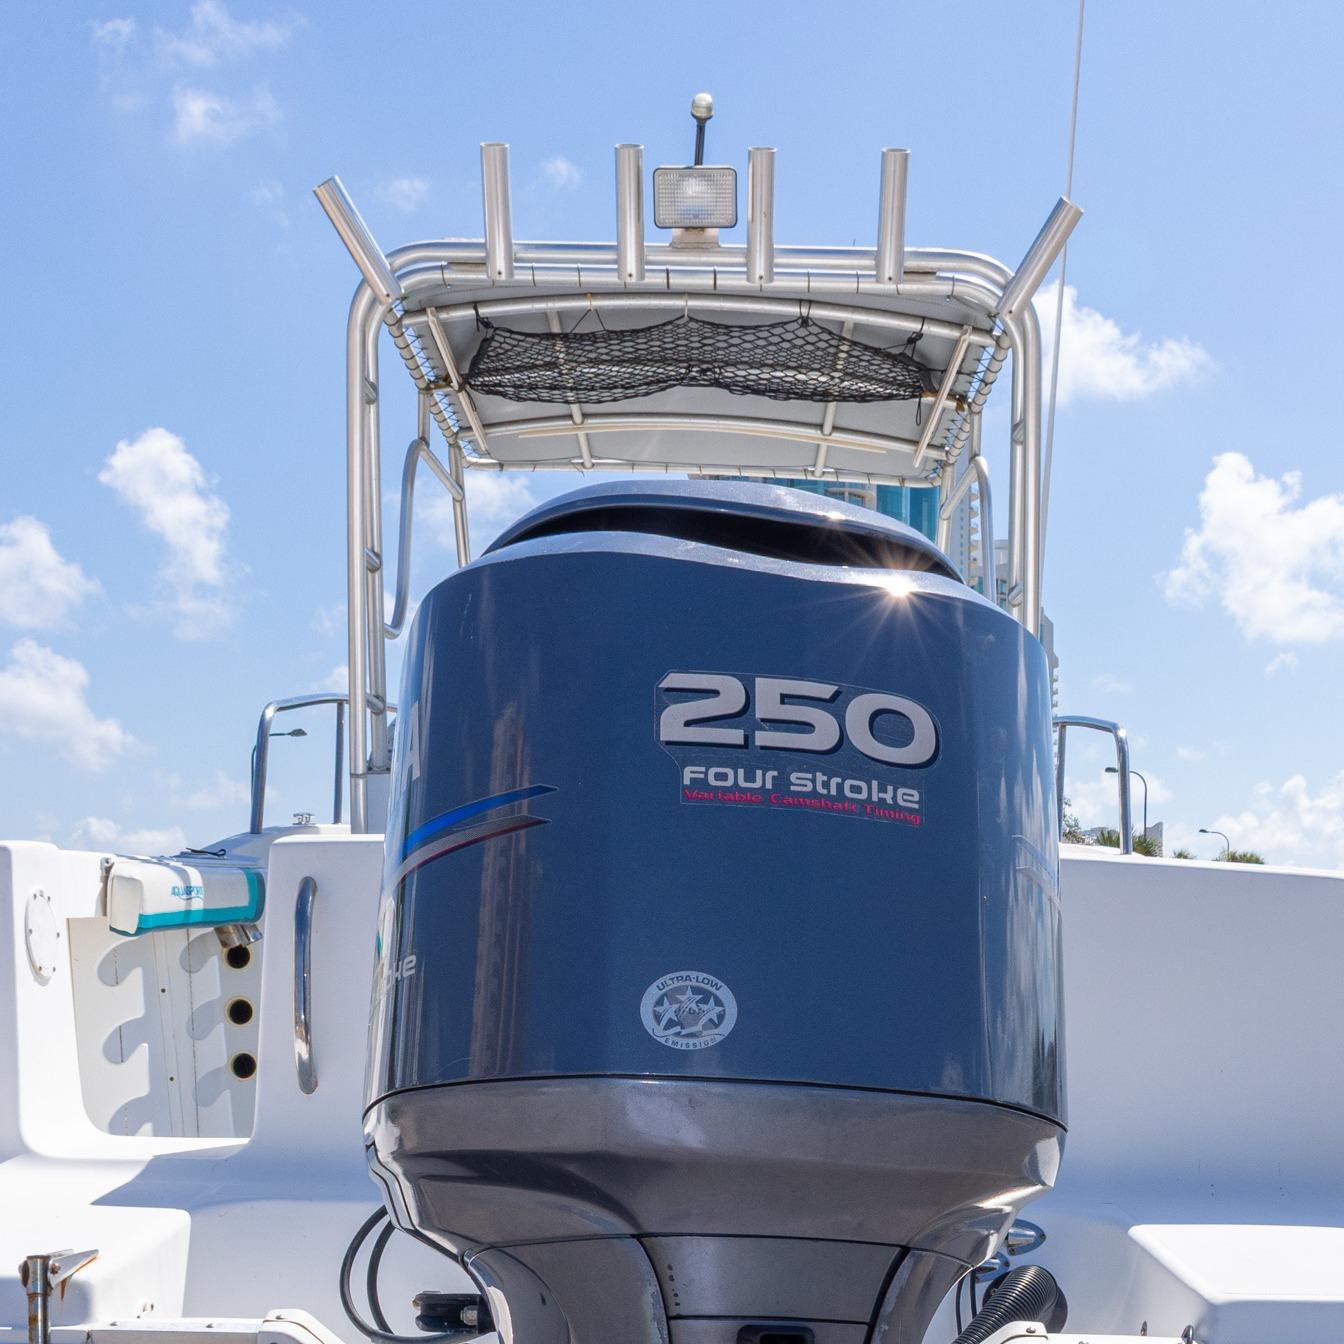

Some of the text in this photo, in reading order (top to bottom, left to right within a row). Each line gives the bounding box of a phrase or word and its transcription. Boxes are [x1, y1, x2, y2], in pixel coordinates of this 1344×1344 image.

[658, 673, 939, 768] 250
[684, 788, 921, 826] Variable Camshaft Timing
